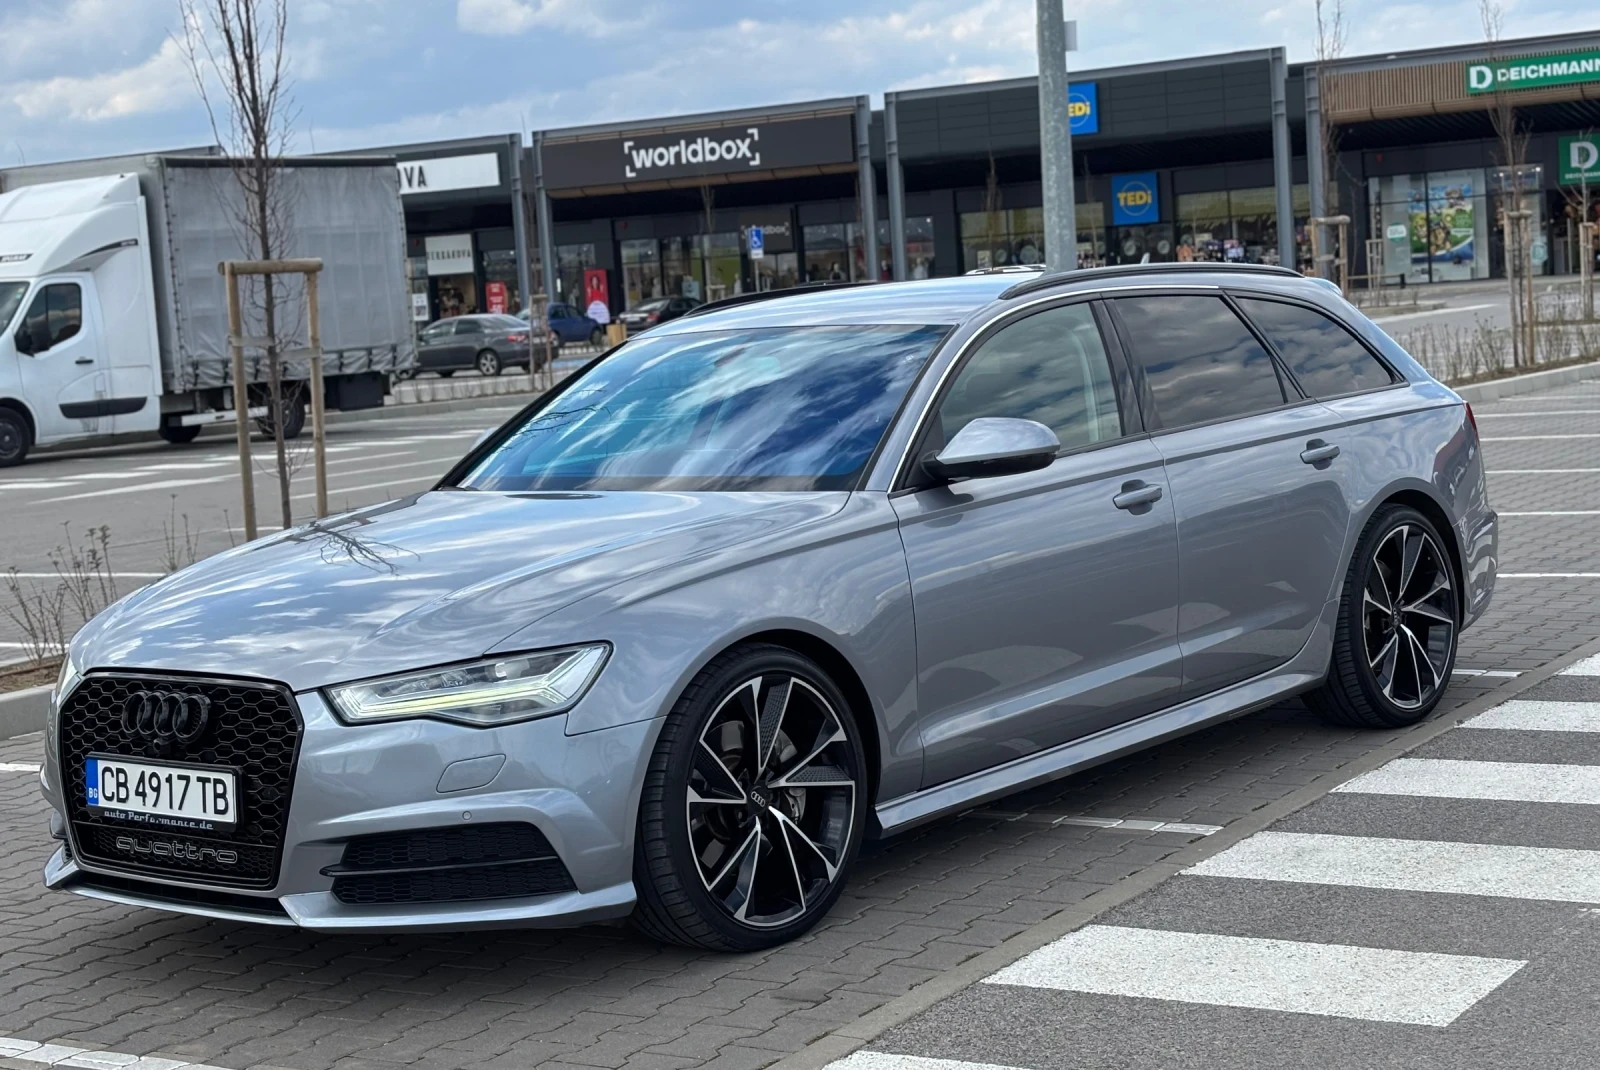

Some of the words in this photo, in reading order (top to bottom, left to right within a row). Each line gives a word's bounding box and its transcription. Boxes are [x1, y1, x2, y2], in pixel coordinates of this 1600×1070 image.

[1067, 101, 1091, 117] EDi
[631, 136, 752, 169] worldbox
[397, 165, 426, 188] VA
[1117, 190, 1152, 206] TEDi
[88, 787, 98, 799] BG
[101, 766, 130, 804] CB
[134, 770, 192, 811] 4917
[196, 776, 229, 816] TB
[104, 810, 126, 819] auto
[115, 836, 238, 863] quattro
